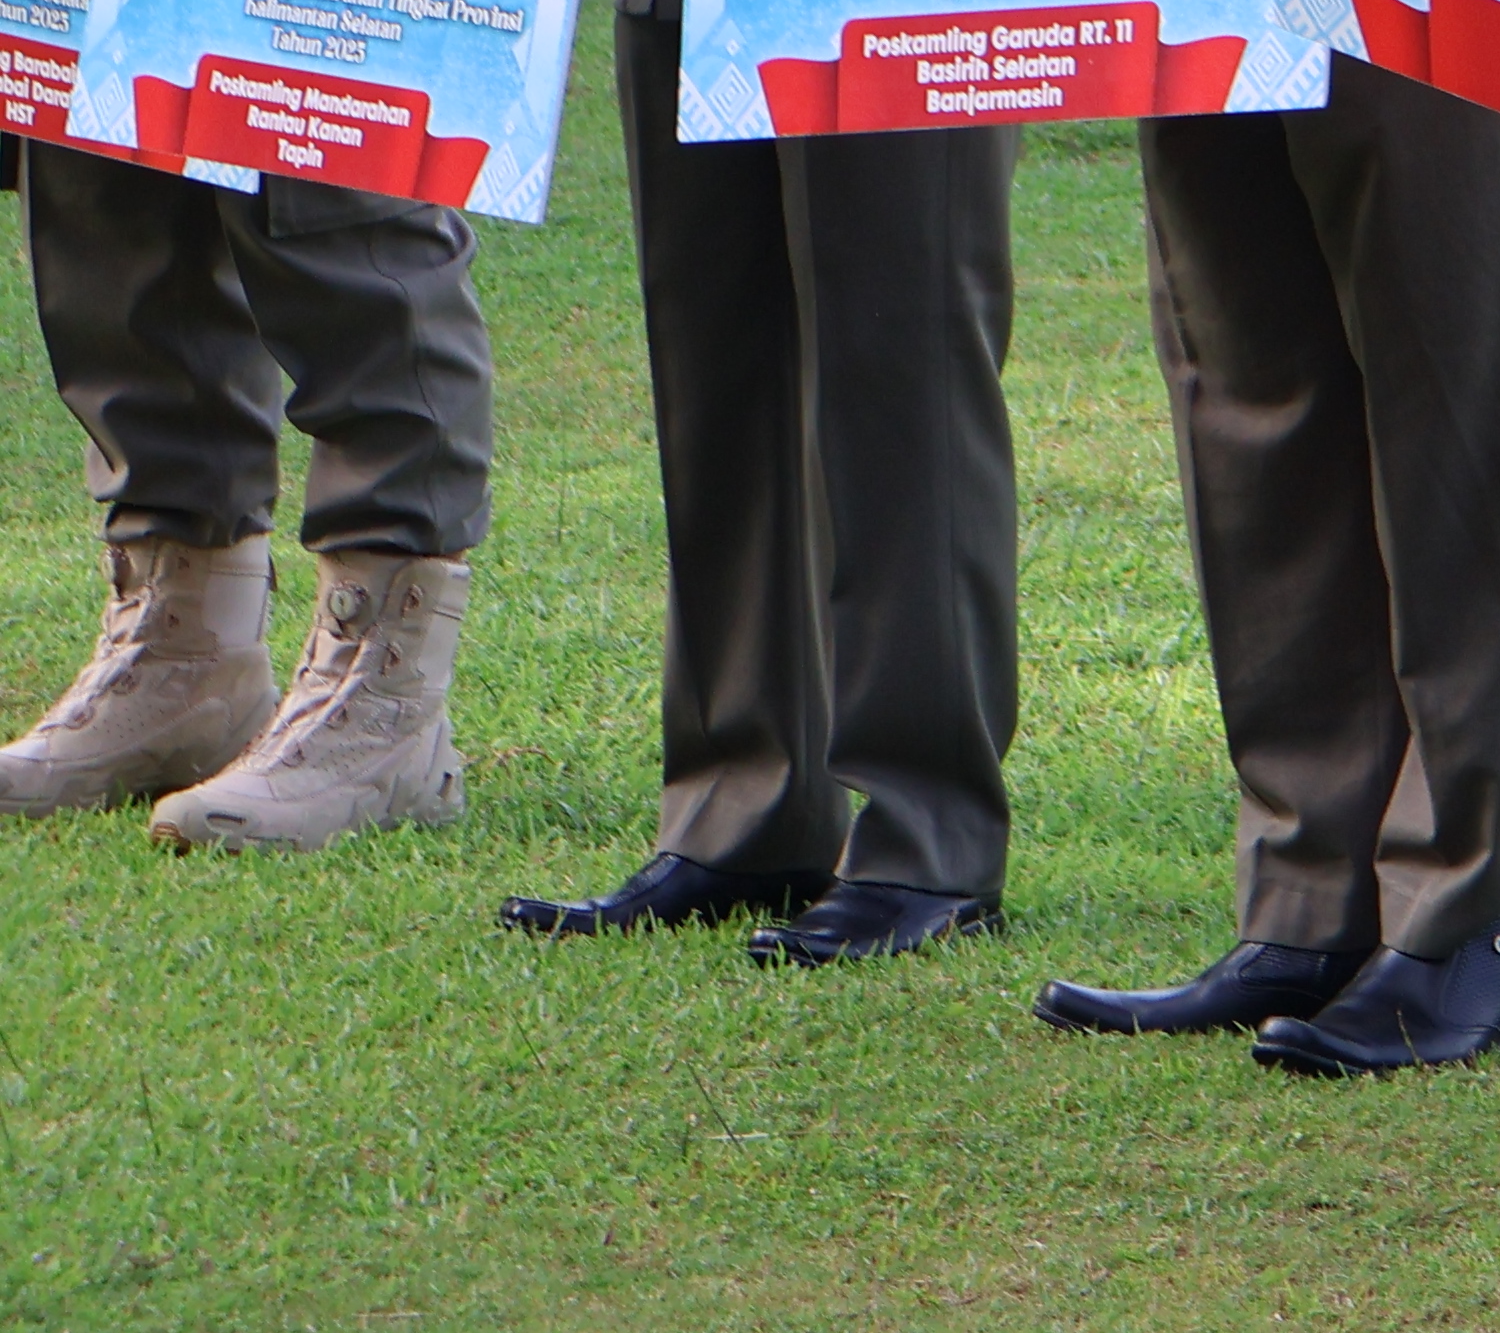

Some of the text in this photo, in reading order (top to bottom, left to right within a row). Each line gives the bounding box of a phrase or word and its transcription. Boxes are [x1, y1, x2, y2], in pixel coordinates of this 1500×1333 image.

[29, 4, 70, 33] 2025
[340, 8, 402, 41] Selatan
[271, 26, 366, 65] Tahun 2025
[862, 28, 987, 65] Poskamling
[991, 23, 1075, 52] Garuda
[1079, 20, 1112, 46] RT.
[916, 52, 1076, 85] Basirih Selatan
[5, 98, 36, 126] HST
[209, 69, 412, 128] Poskamling Mandarahan
[925, 83, 1063, 118] Banjarmasin
[247, 104, 363, 149] Rantau Kanan
[278, 139, 324, 170] Tapin
